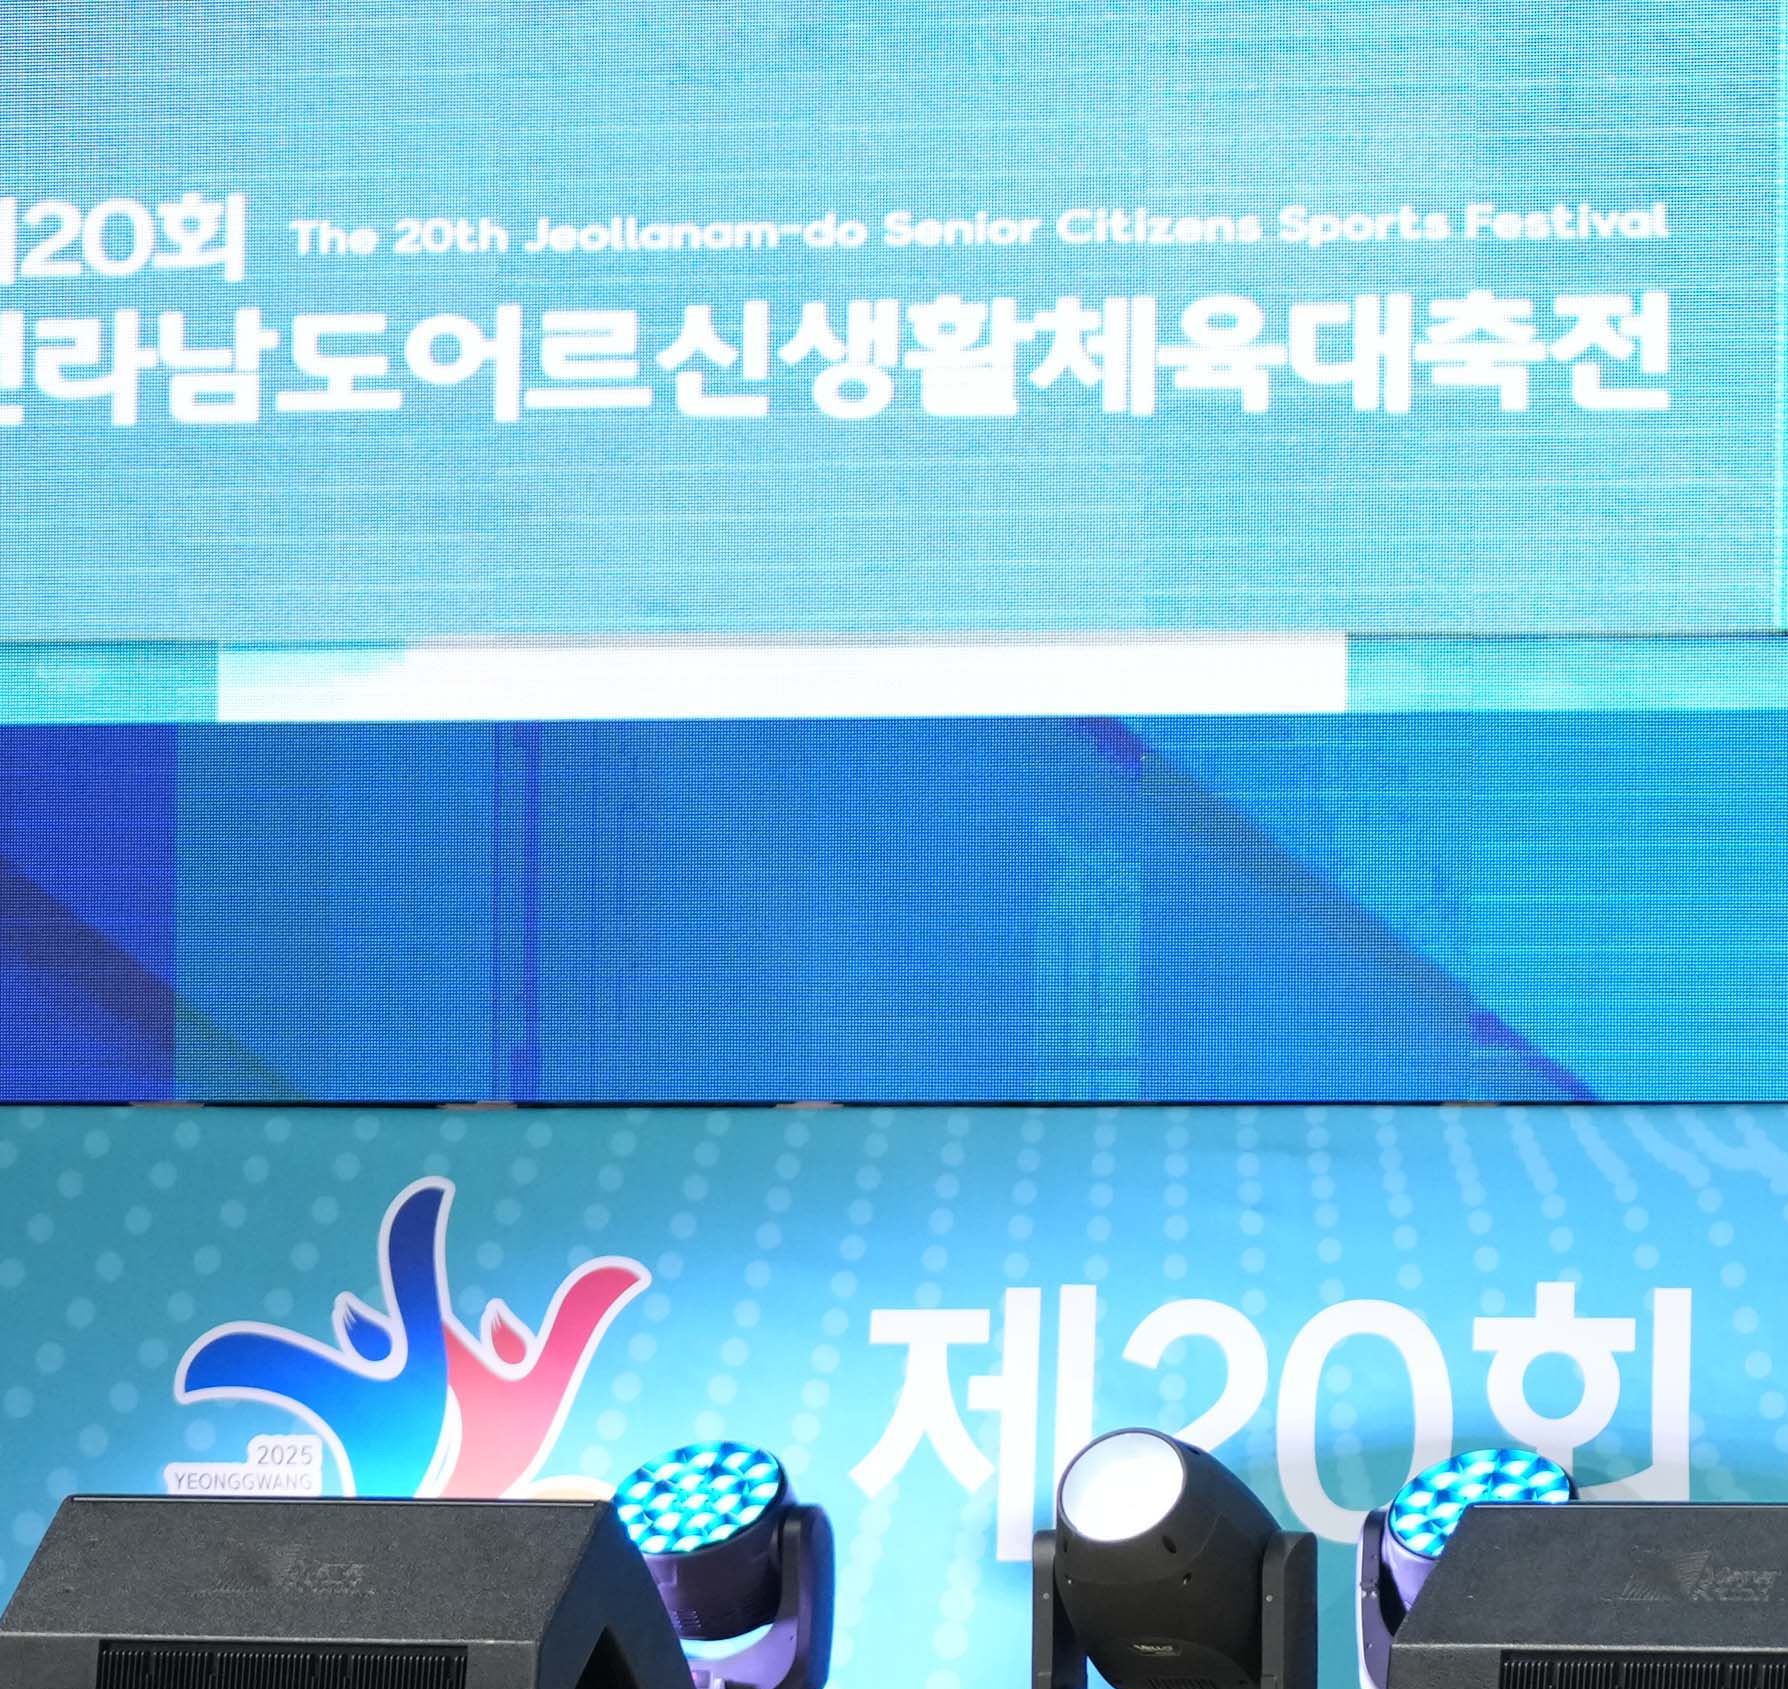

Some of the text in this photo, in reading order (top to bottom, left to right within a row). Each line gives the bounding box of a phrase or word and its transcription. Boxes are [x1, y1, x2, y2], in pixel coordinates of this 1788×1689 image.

[290, 219, 378, 254] The
[395, 217, 508, 253] 20th
[525, 212, 867, 252] Jeollanam-do
[884, 210, 1040, 247] Senior
[1056, 207, 1262, 244] Citizens
[1278, 205, 1450, 247] Sports
[1464, 202, 1668, 240] Festival
[256, 1444, 313, 1466] 2025
[174, 1471, 313, 1491] YEONGGWANG
